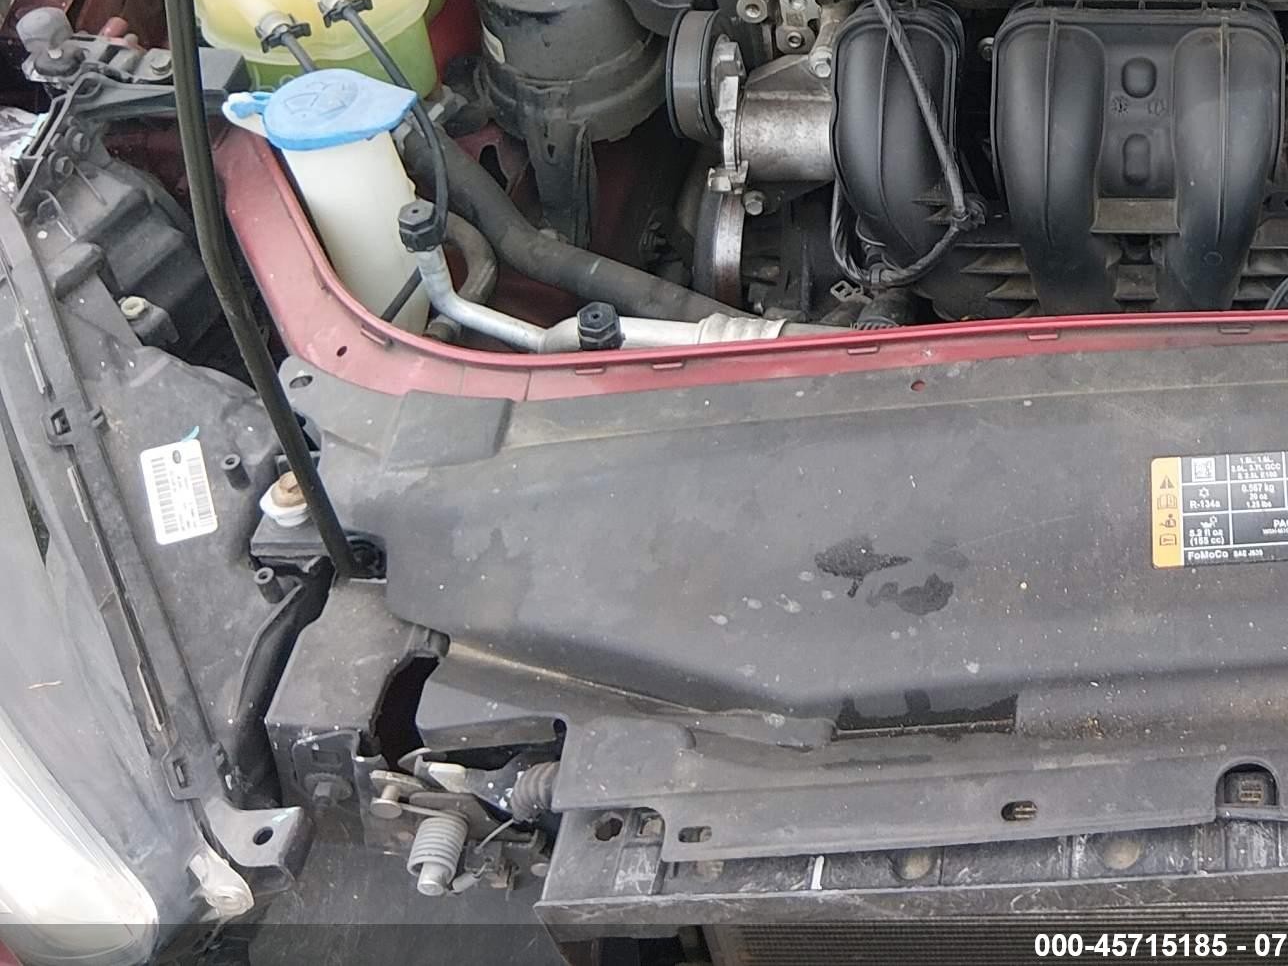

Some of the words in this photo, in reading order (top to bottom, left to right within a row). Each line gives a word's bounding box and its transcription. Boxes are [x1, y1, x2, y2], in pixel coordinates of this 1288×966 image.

[1189, 500, 1221, 509] R-134a
[1210, 536, 1225, 545] cc)
[1187, 549, 1229, 560] FoMoCo
